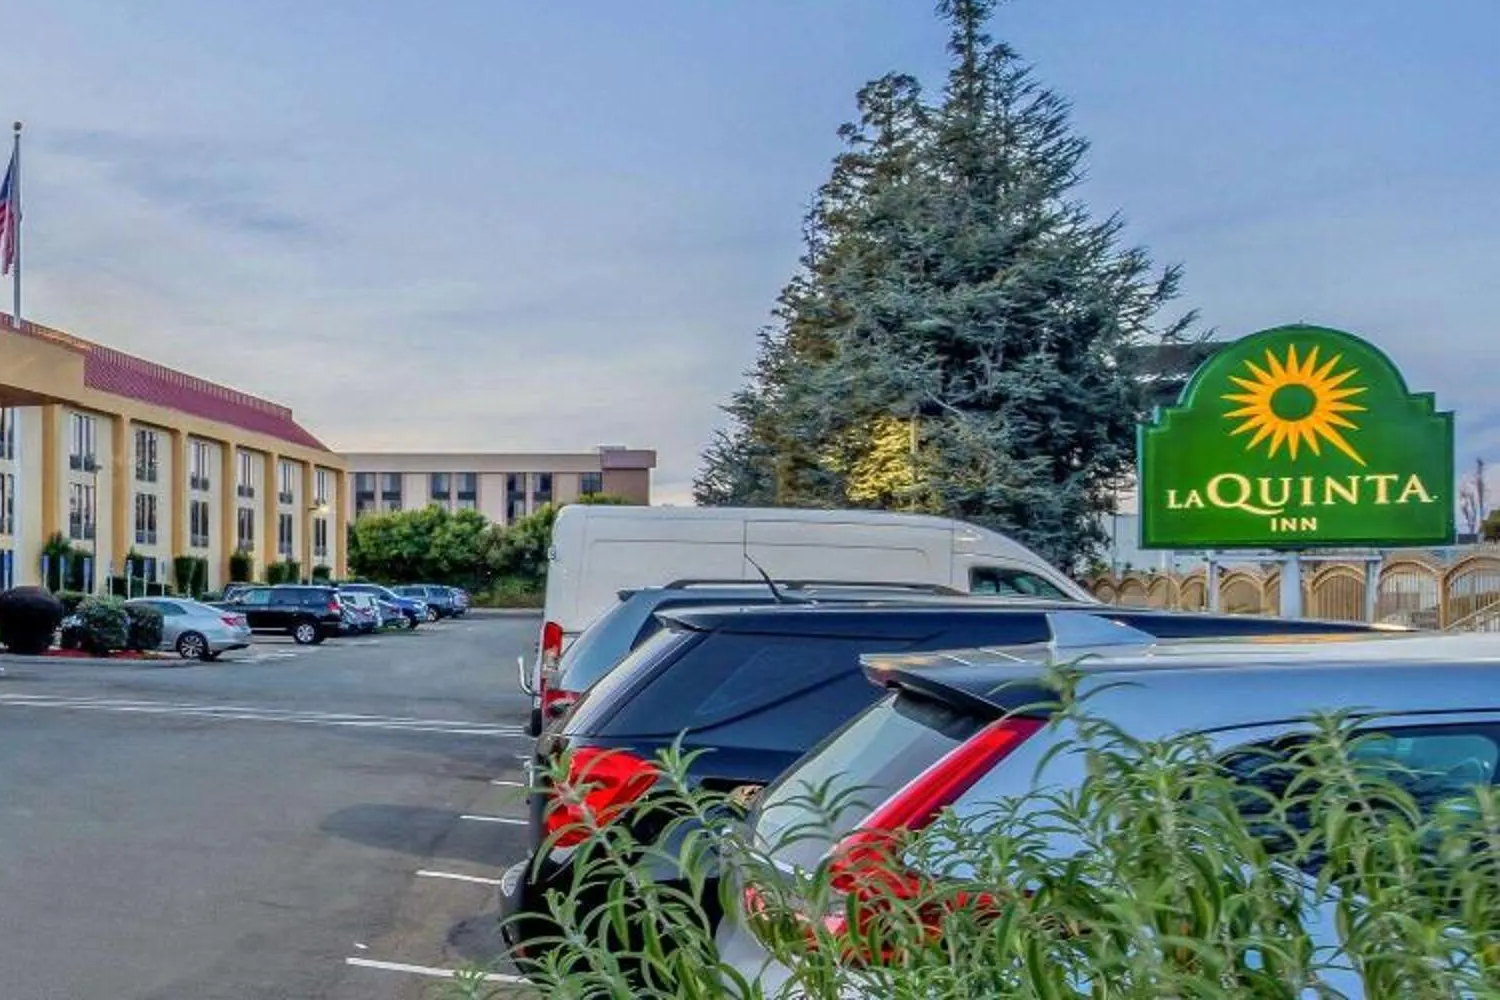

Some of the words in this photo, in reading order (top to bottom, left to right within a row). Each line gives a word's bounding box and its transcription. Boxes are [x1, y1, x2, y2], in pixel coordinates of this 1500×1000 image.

[1166, 489, 1204, 509] LA
[1206, 473, 1434, 515] QUINTA
[1270, 517, 1317, 532] INN
